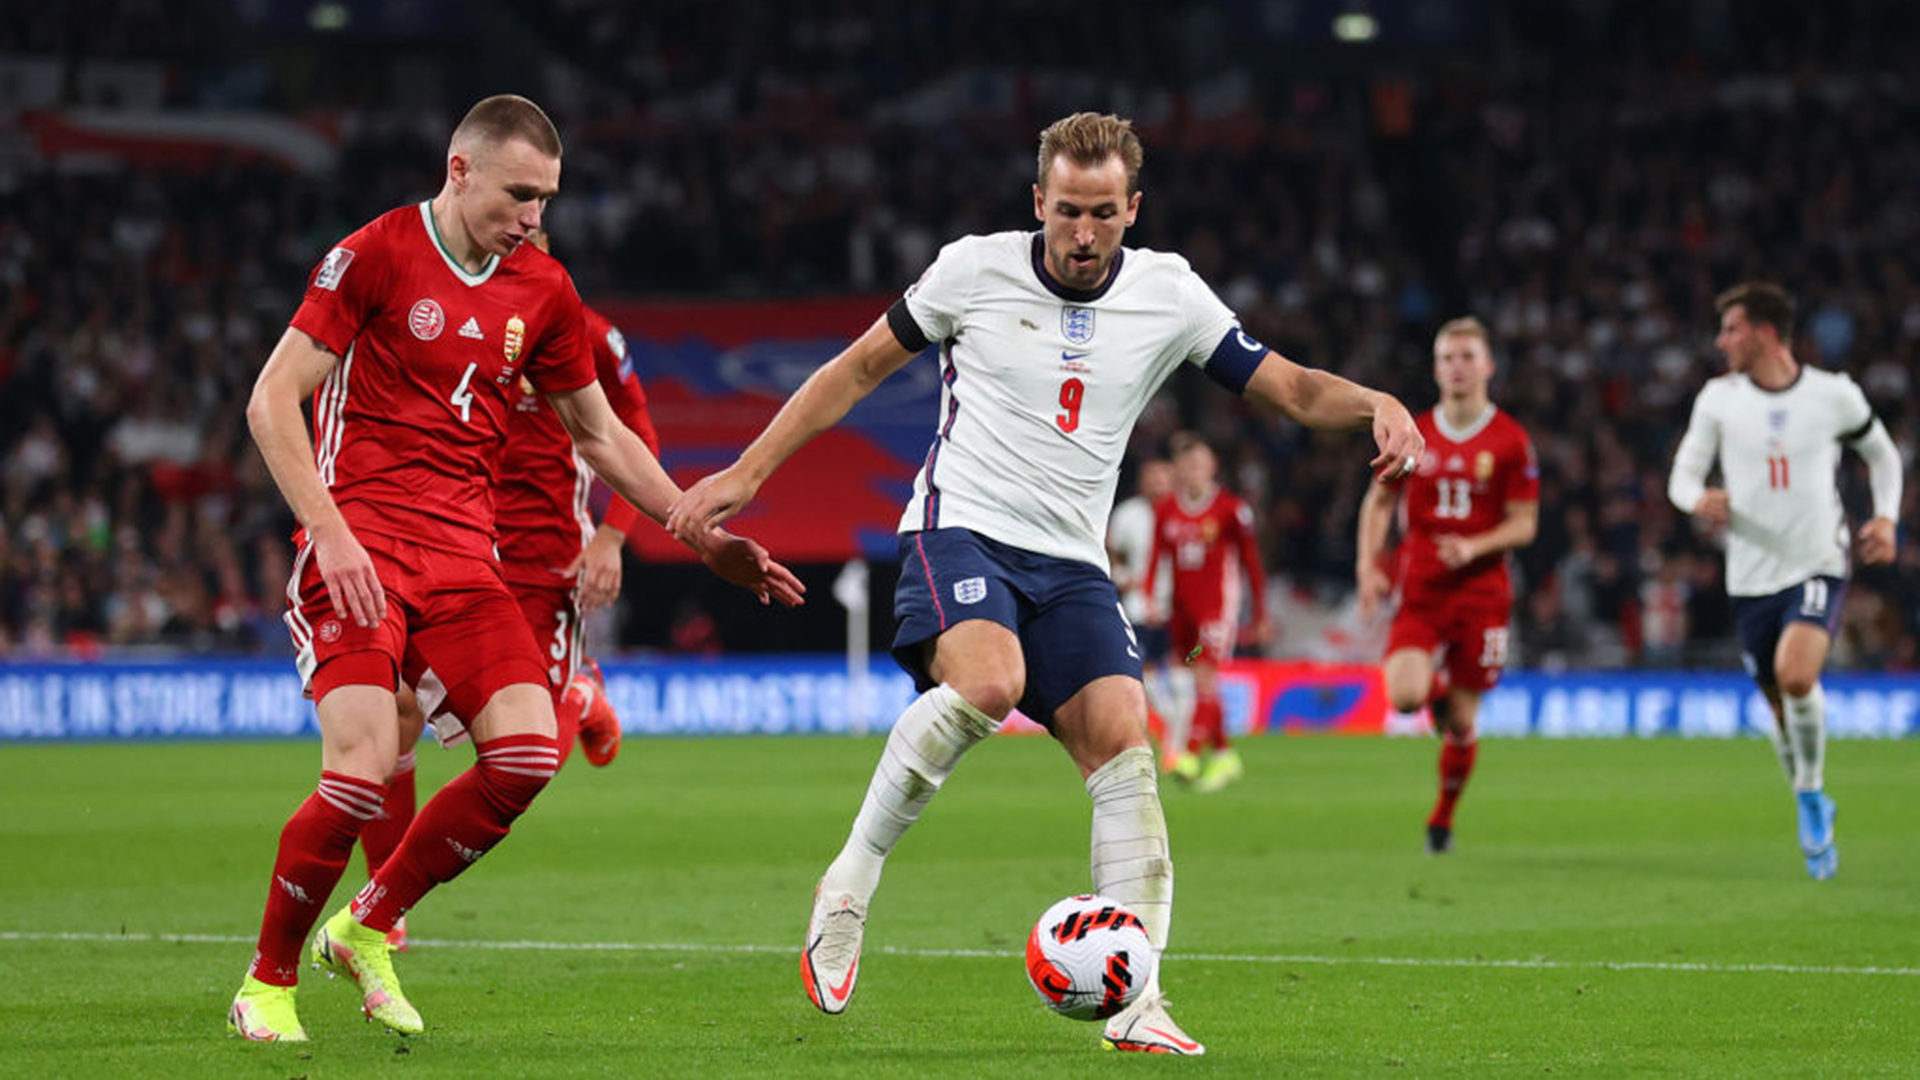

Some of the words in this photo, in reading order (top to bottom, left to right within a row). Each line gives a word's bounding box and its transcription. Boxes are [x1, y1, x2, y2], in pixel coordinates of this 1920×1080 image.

[450, 361, 478, 422] 4
[1056, 377, 1084, 434] 9
[1767, 456, 1790, 490] 11
[1434, 477, 1472, 521] 13
[1804, 578, 1828, 611] 11
[549, 610, 568, 661] 3
[114, 673, 224, 735] STORE
[228, 673, 303, 735] AND
[1744, 688, 1918, 738] SORE
